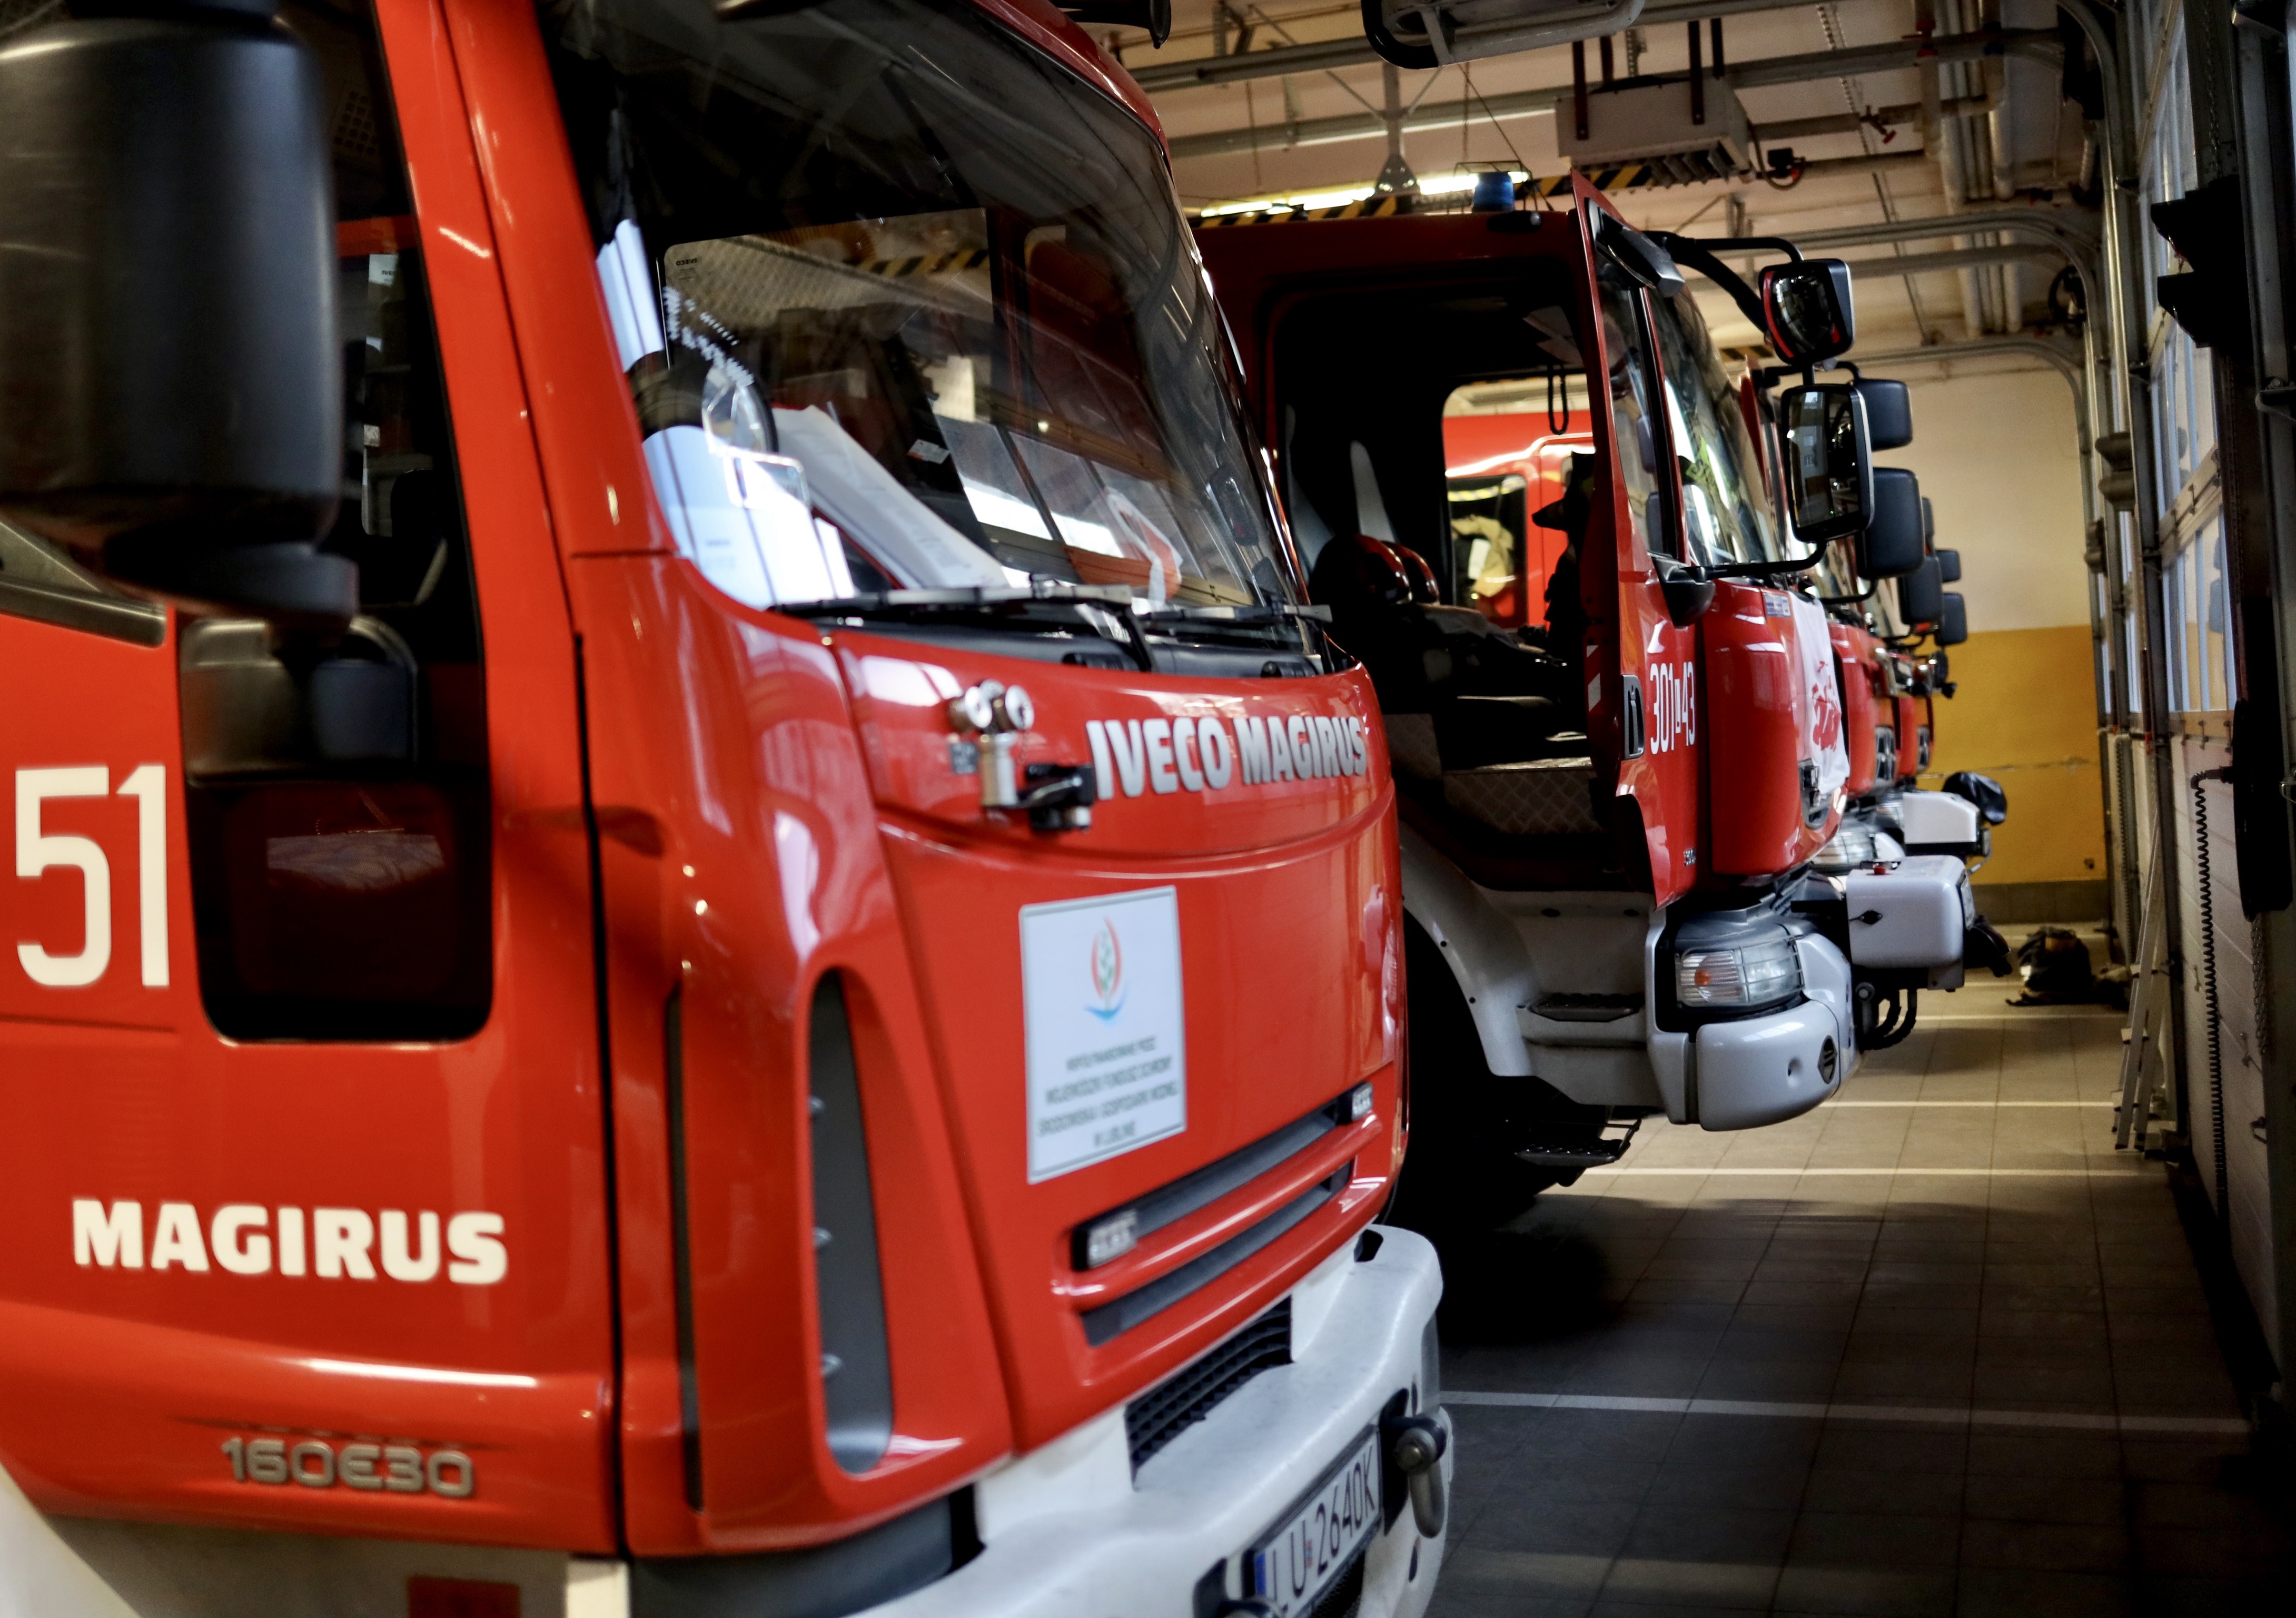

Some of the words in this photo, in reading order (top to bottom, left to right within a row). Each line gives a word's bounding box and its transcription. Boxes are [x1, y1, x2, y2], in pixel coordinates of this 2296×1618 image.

[1086, 717, 1232, 801] IVECO
[1232, 715, 1367, 785] MAGIRUS
[15, 763, 170, 988] 51
[72, 1197, 509, 1285] MAGIRUS
[222, 1436, 476, 1499] 160E30
[1317, 1445, 1375, 1576] 2640K
